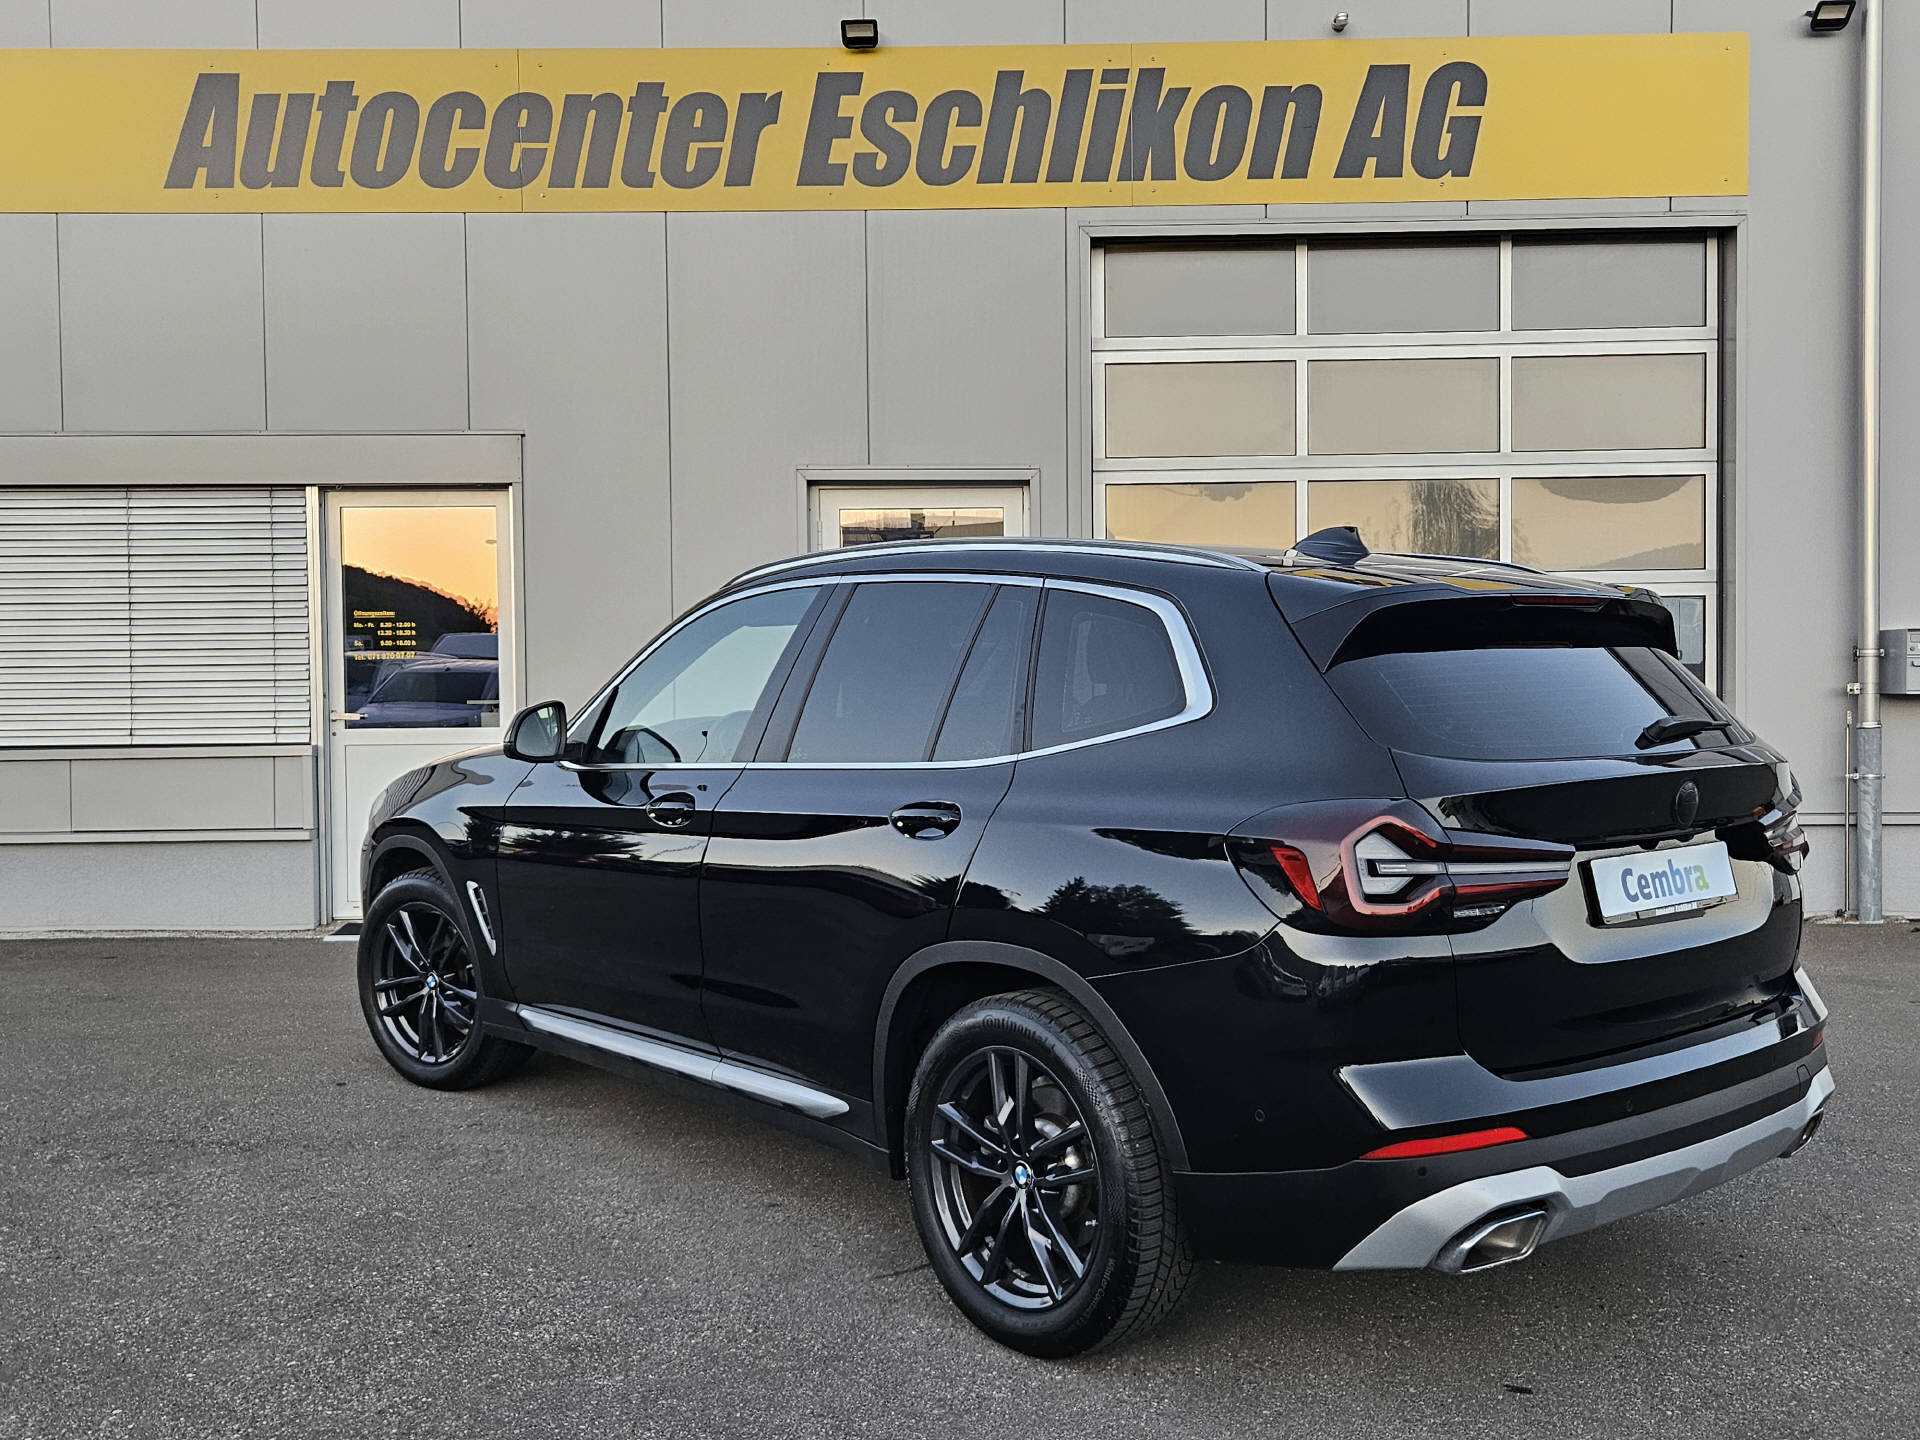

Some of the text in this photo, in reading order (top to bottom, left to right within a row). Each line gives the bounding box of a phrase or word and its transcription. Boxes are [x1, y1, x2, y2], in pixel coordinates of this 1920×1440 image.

[164, 61, 1488, 191] Autocenter Eschlikon AG
[1620, 858, 1709, 903] Cembra
